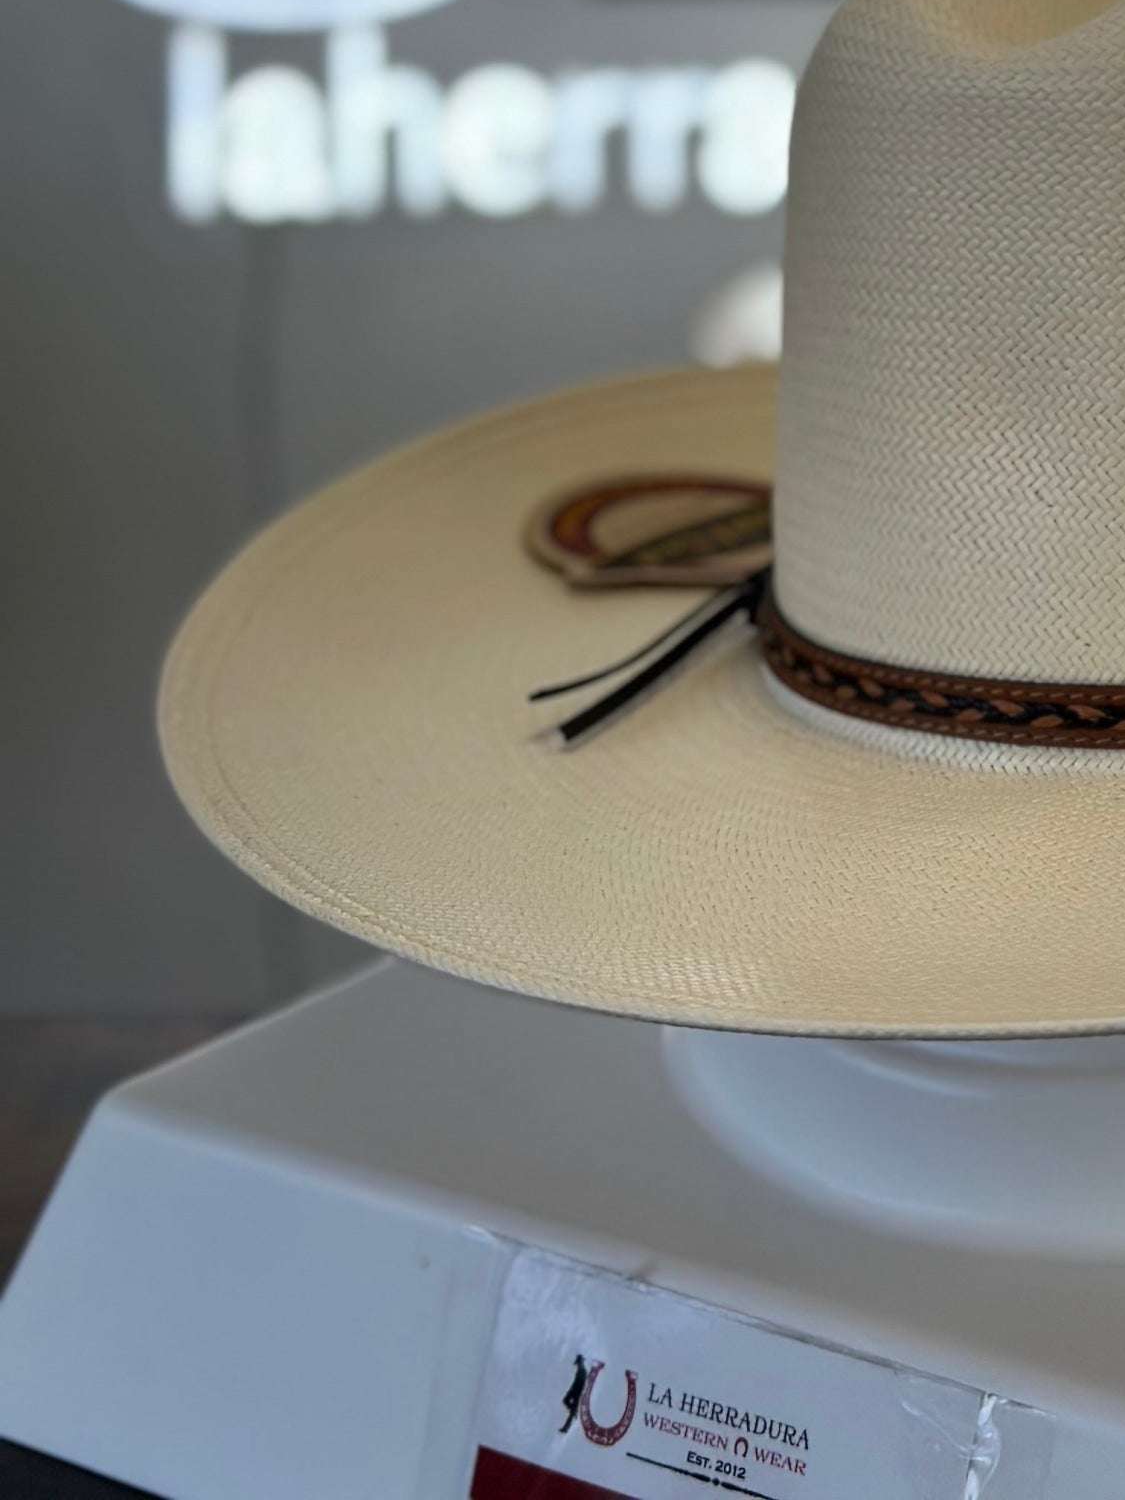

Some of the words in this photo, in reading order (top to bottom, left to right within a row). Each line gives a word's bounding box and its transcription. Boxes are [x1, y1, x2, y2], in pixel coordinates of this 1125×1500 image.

[643, 1411, 729, 1451] WESTERN
[754, 1446, 808, 1477] WEAR
[647, 1382, 674, 1409] LA
[679, 1392, 810, 1451] HERRADURA
[714, 1459, 748, 1480] 2012
